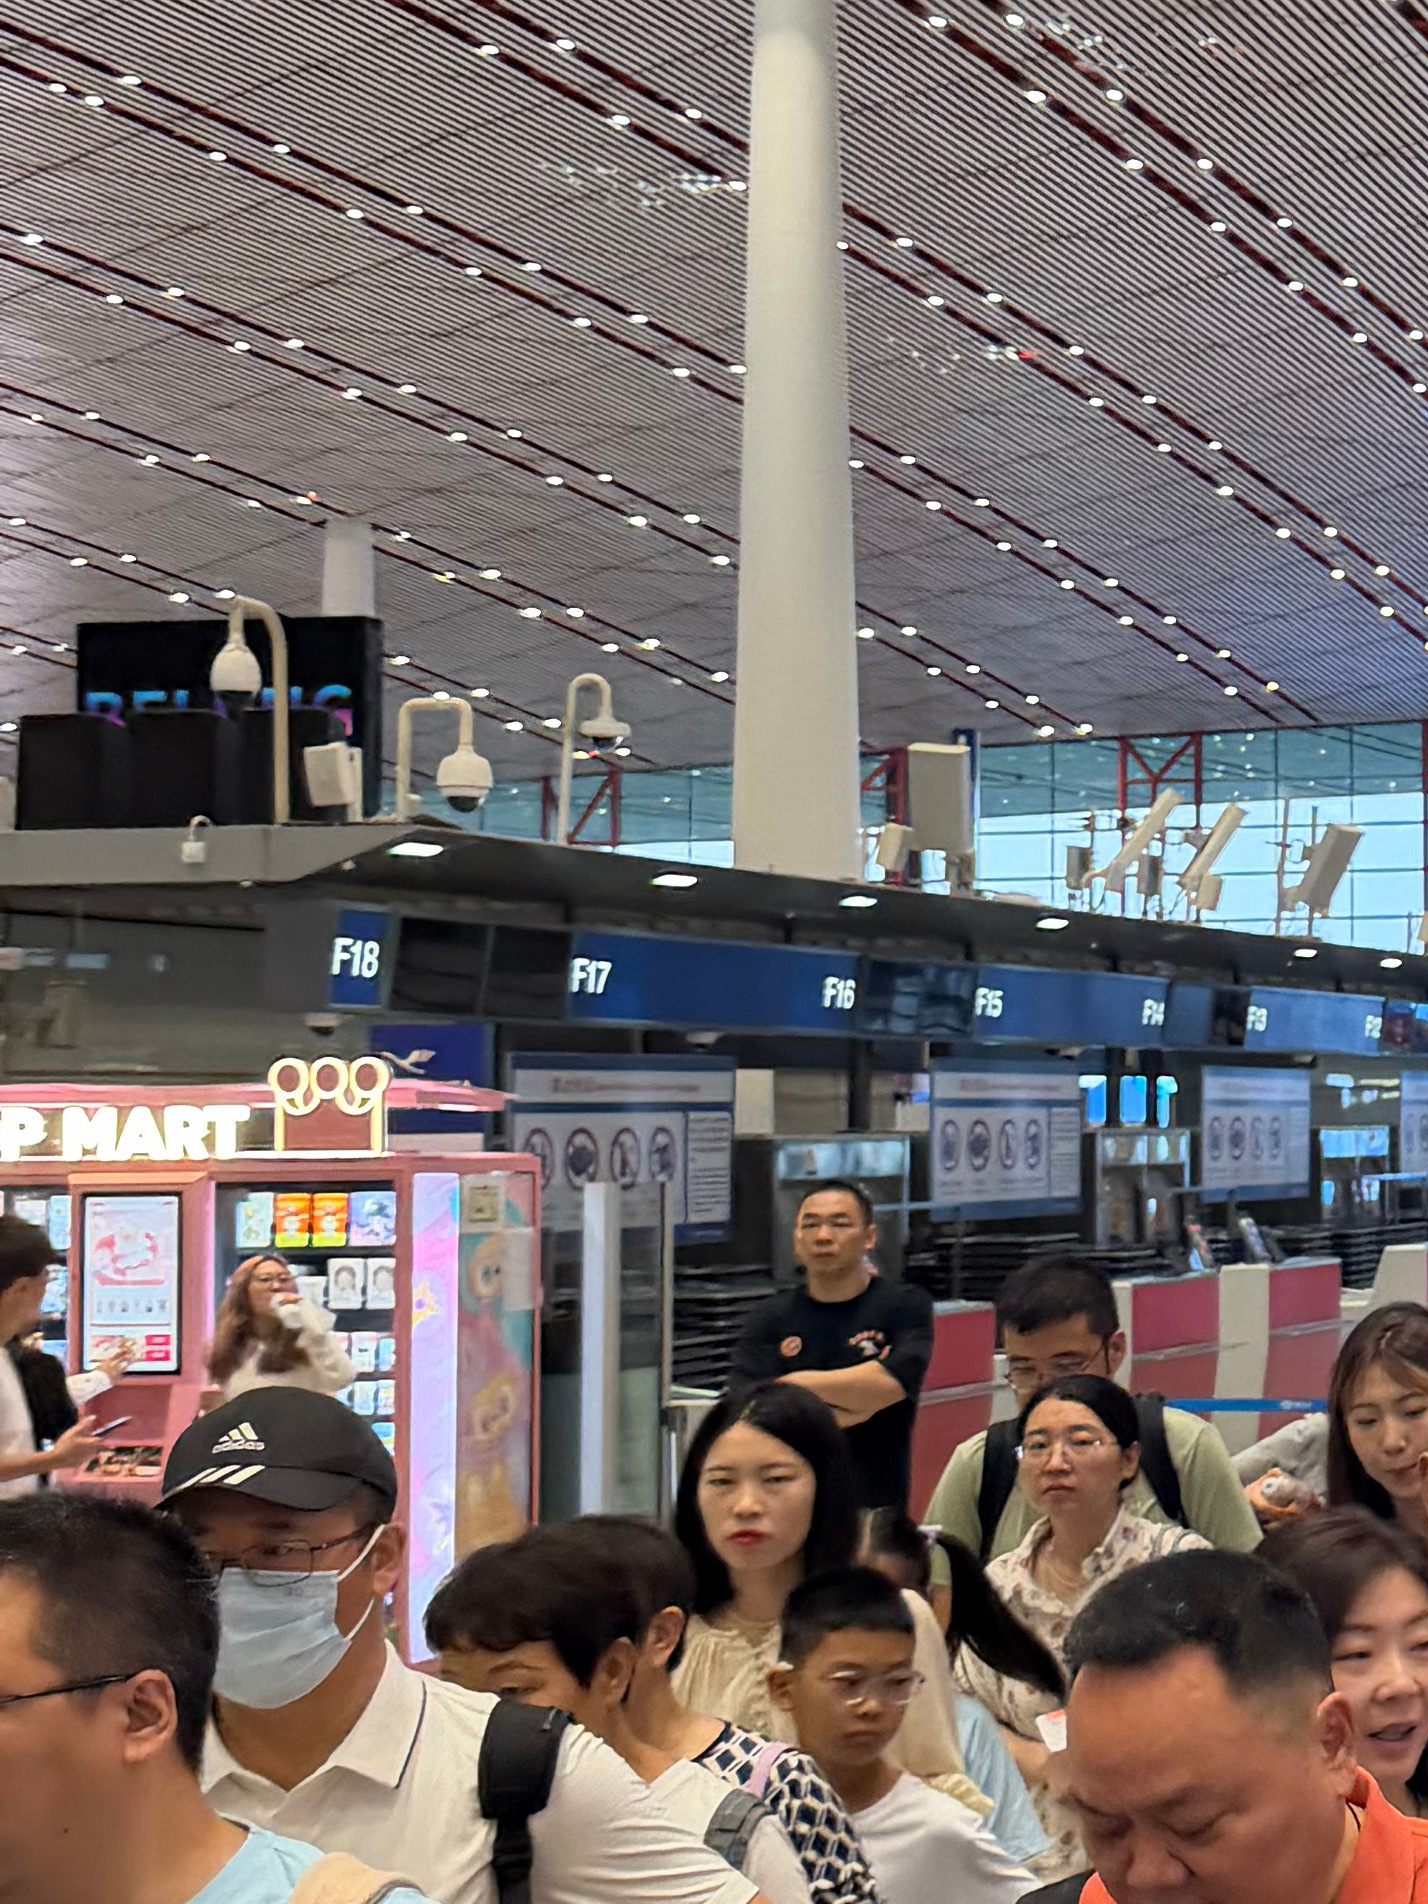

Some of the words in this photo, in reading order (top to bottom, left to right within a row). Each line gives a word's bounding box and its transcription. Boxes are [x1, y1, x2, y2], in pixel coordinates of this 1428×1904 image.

[331, 937, 380, 978] F18
[570, 957, 612, 994] F17
[823, 976, 856, 1010] F16
[975, 987, 1004, 1018] F15
[62, 1104, 251, 1162] MART
